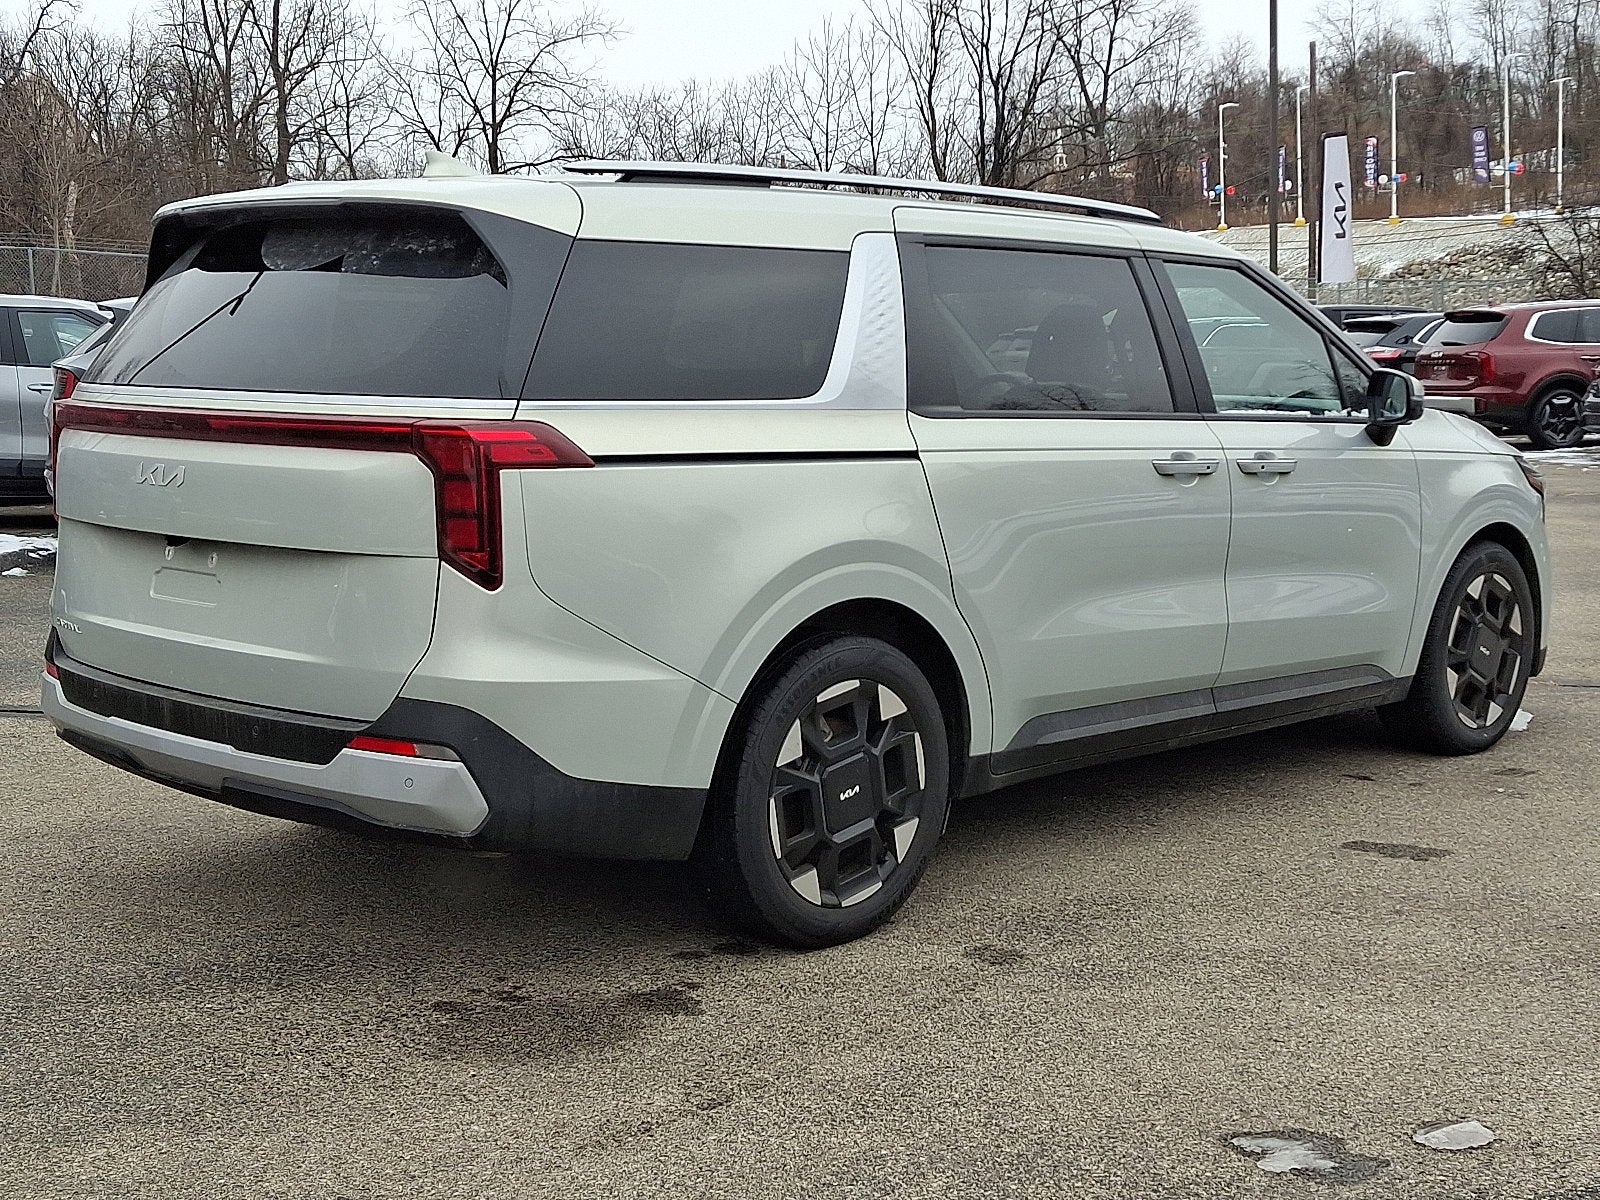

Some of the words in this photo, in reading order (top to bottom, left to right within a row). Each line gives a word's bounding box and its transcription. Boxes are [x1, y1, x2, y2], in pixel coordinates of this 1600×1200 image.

[1334, 182, 1346, 239] KIA
[136, 461, 186, 488] KIA
[839, 785, 860, 801] KIA
